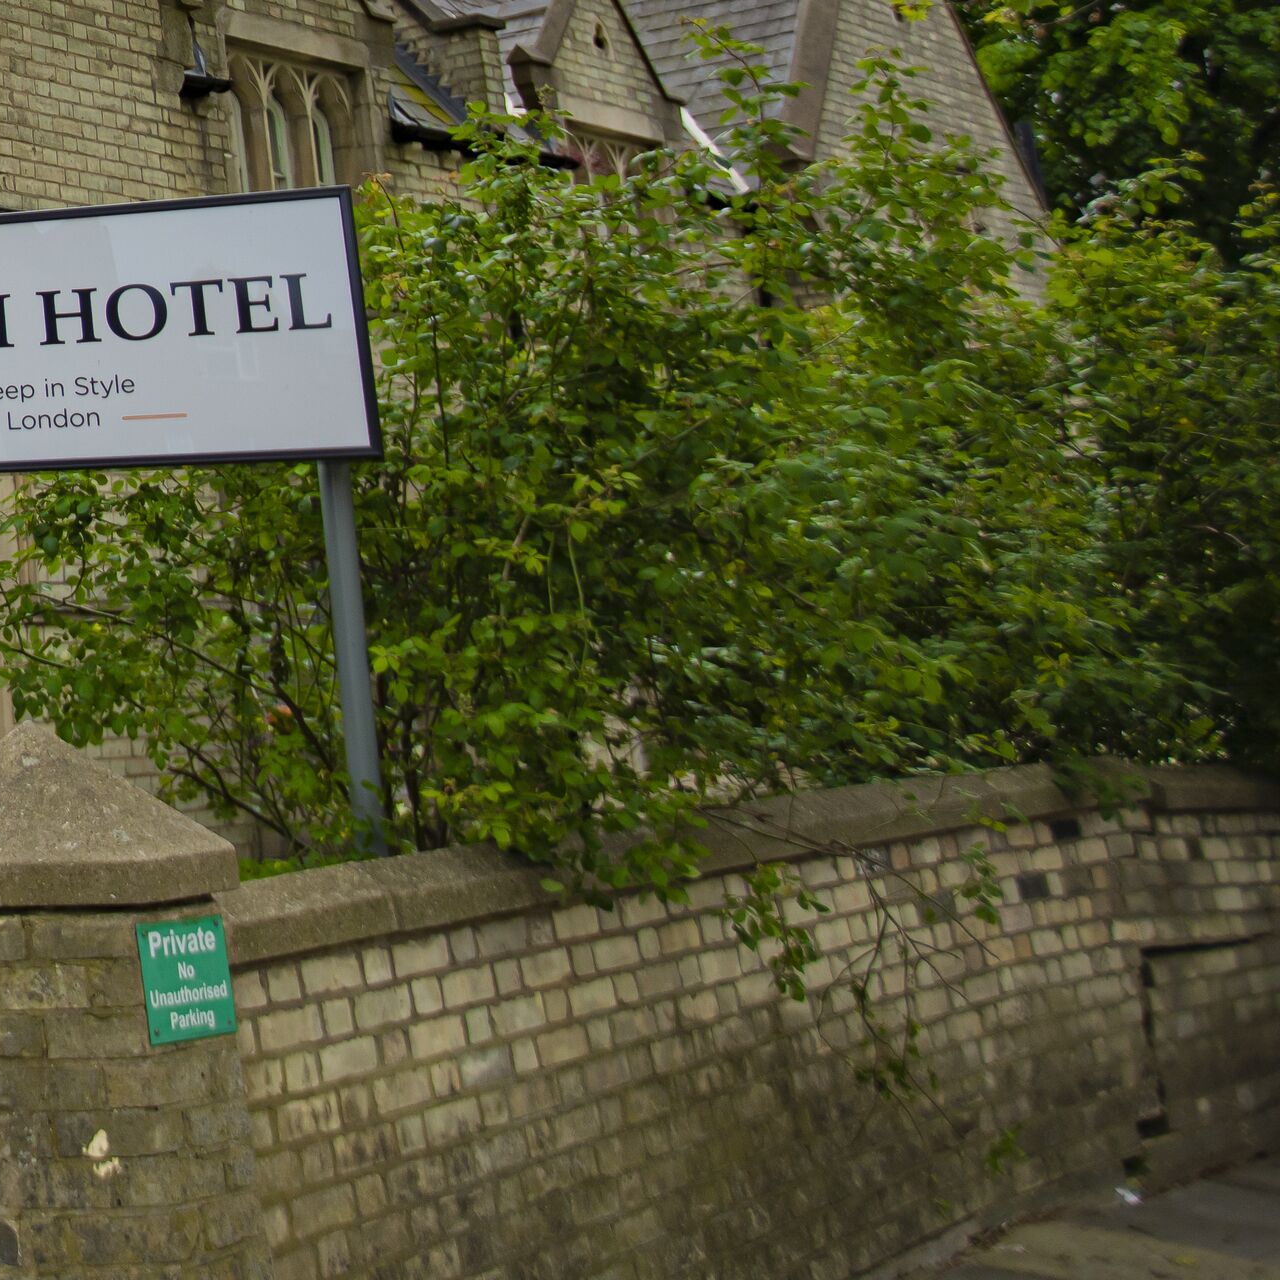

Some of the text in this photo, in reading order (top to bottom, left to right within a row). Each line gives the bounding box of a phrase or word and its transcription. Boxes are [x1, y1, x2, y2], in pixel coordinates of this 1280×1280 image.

[35, 273, 333, 346] HOTEL
[44, 378, 65, 398] in
[74, 374, 136, 400] Style
[7, 407, 101, 431] London
[147, 926, 217, 959] Private
[177, 961, 196, 980] No
[149, 979, 228, 1009] Unauthorised
[169, 1007, 217, 1031] Parking
